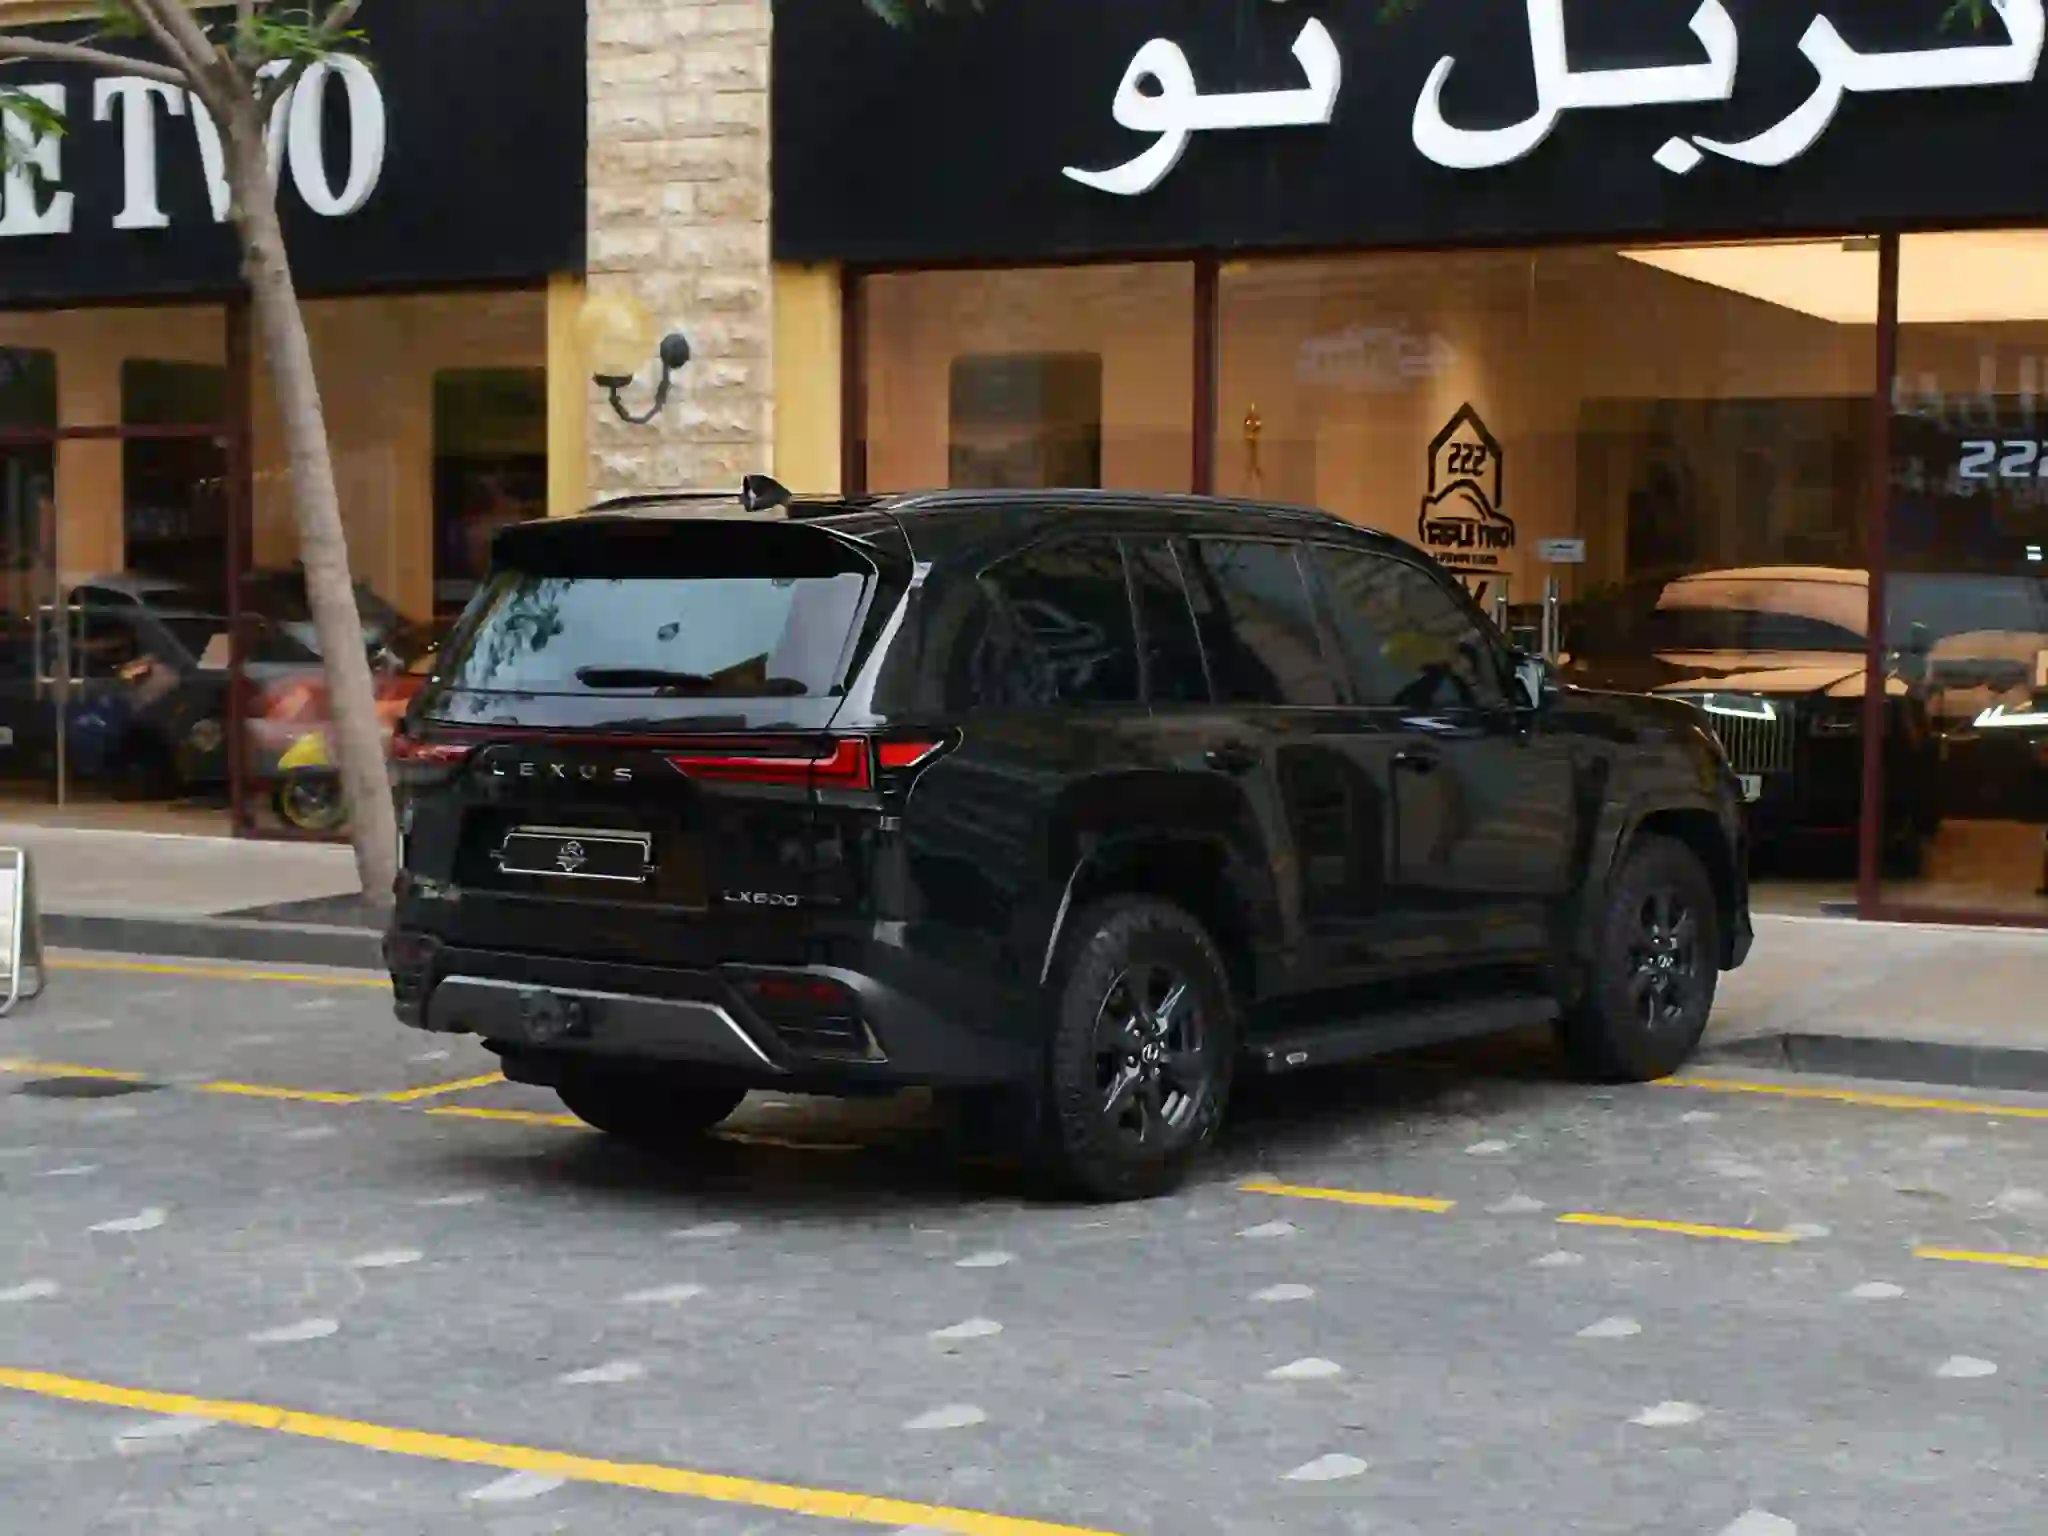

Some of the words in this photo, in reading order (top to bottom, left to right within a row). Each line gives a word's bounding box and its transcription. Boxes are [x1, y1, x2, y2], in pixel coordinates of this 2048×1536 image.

[1447, 442, 1488, 477] 222
[491, 760, 633, 782] LEXUS
[723, 889, 798, 907] LX600
